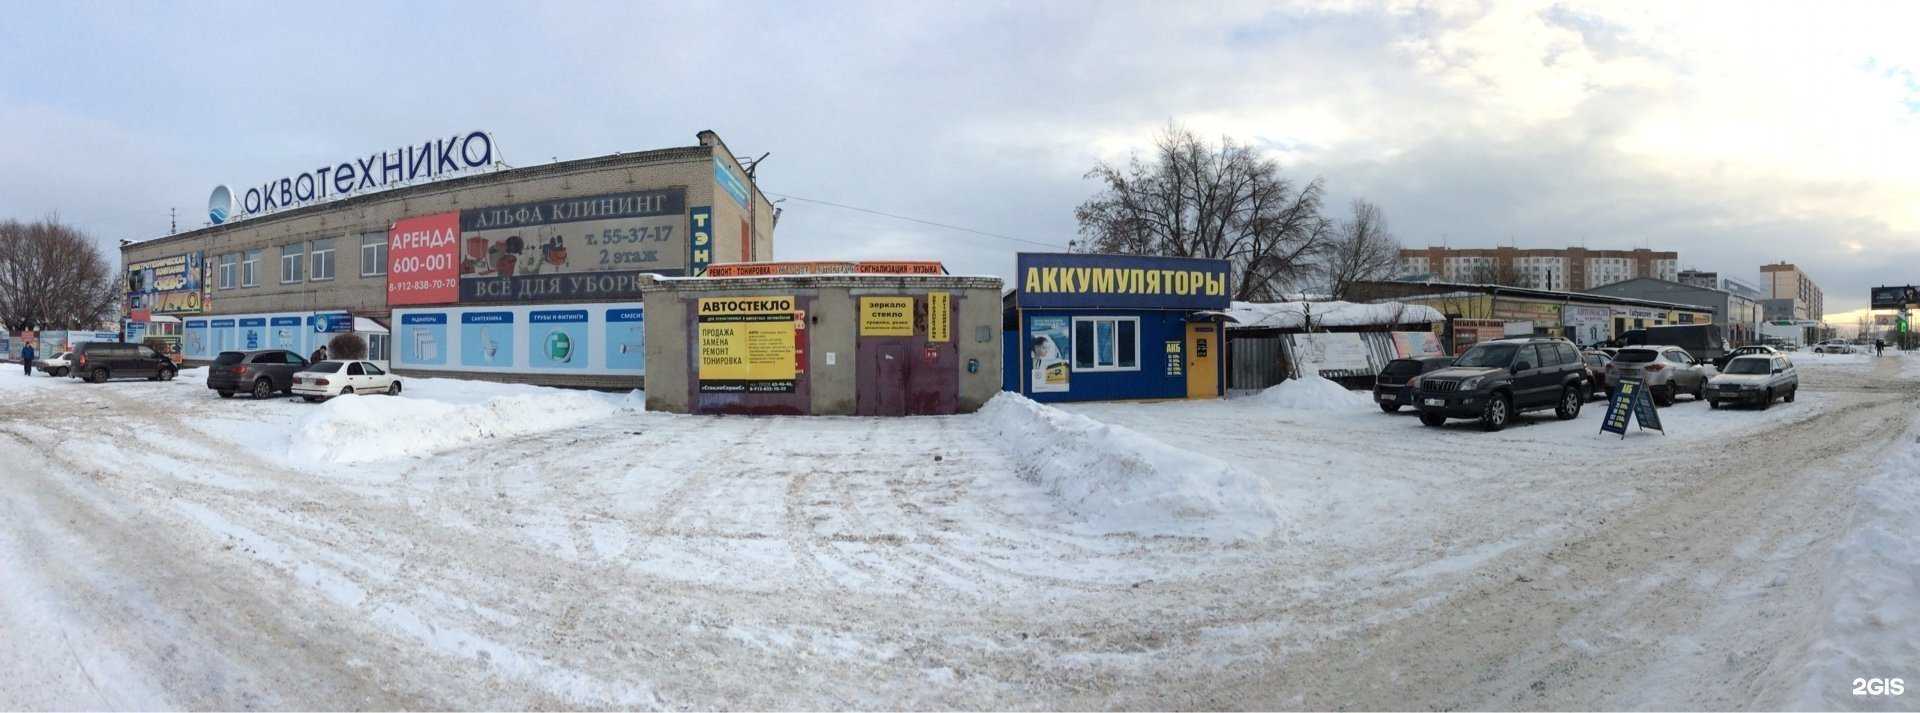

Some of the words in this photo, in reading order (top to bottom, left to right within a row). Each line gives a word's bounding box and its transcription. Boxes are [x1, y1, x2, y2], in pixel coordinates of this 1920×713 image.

[476, 207, 544, 228] АЛЬФА
[551, 195, 667, 220] КЛИНИНГ
[391, 227, 456, 251] АРЕНДА
[602, 225, 674, 245] 55-37-17
[393, 253, 452, 274] 600-001
[600, 251, 610, 264] 2
[613, 250, 658, 263] этаж
[913, 265, 938, 274] МУЗЫКА
[518, 278, 561, 298] ДЛЯ
[1025, 266, 1226, 297] АККУМУЛЯТОРЫ
[702, 300, 791, 312] АВТОСТЕКЛО
[702, 328, 735, 337] ПРОДАЖА
[702, 338, 729, 346] ЗАМЕНА
[702, 347, 729, 356] РЕМОНТ
[703, 356, 742, 365] ТОНИРОВКА
